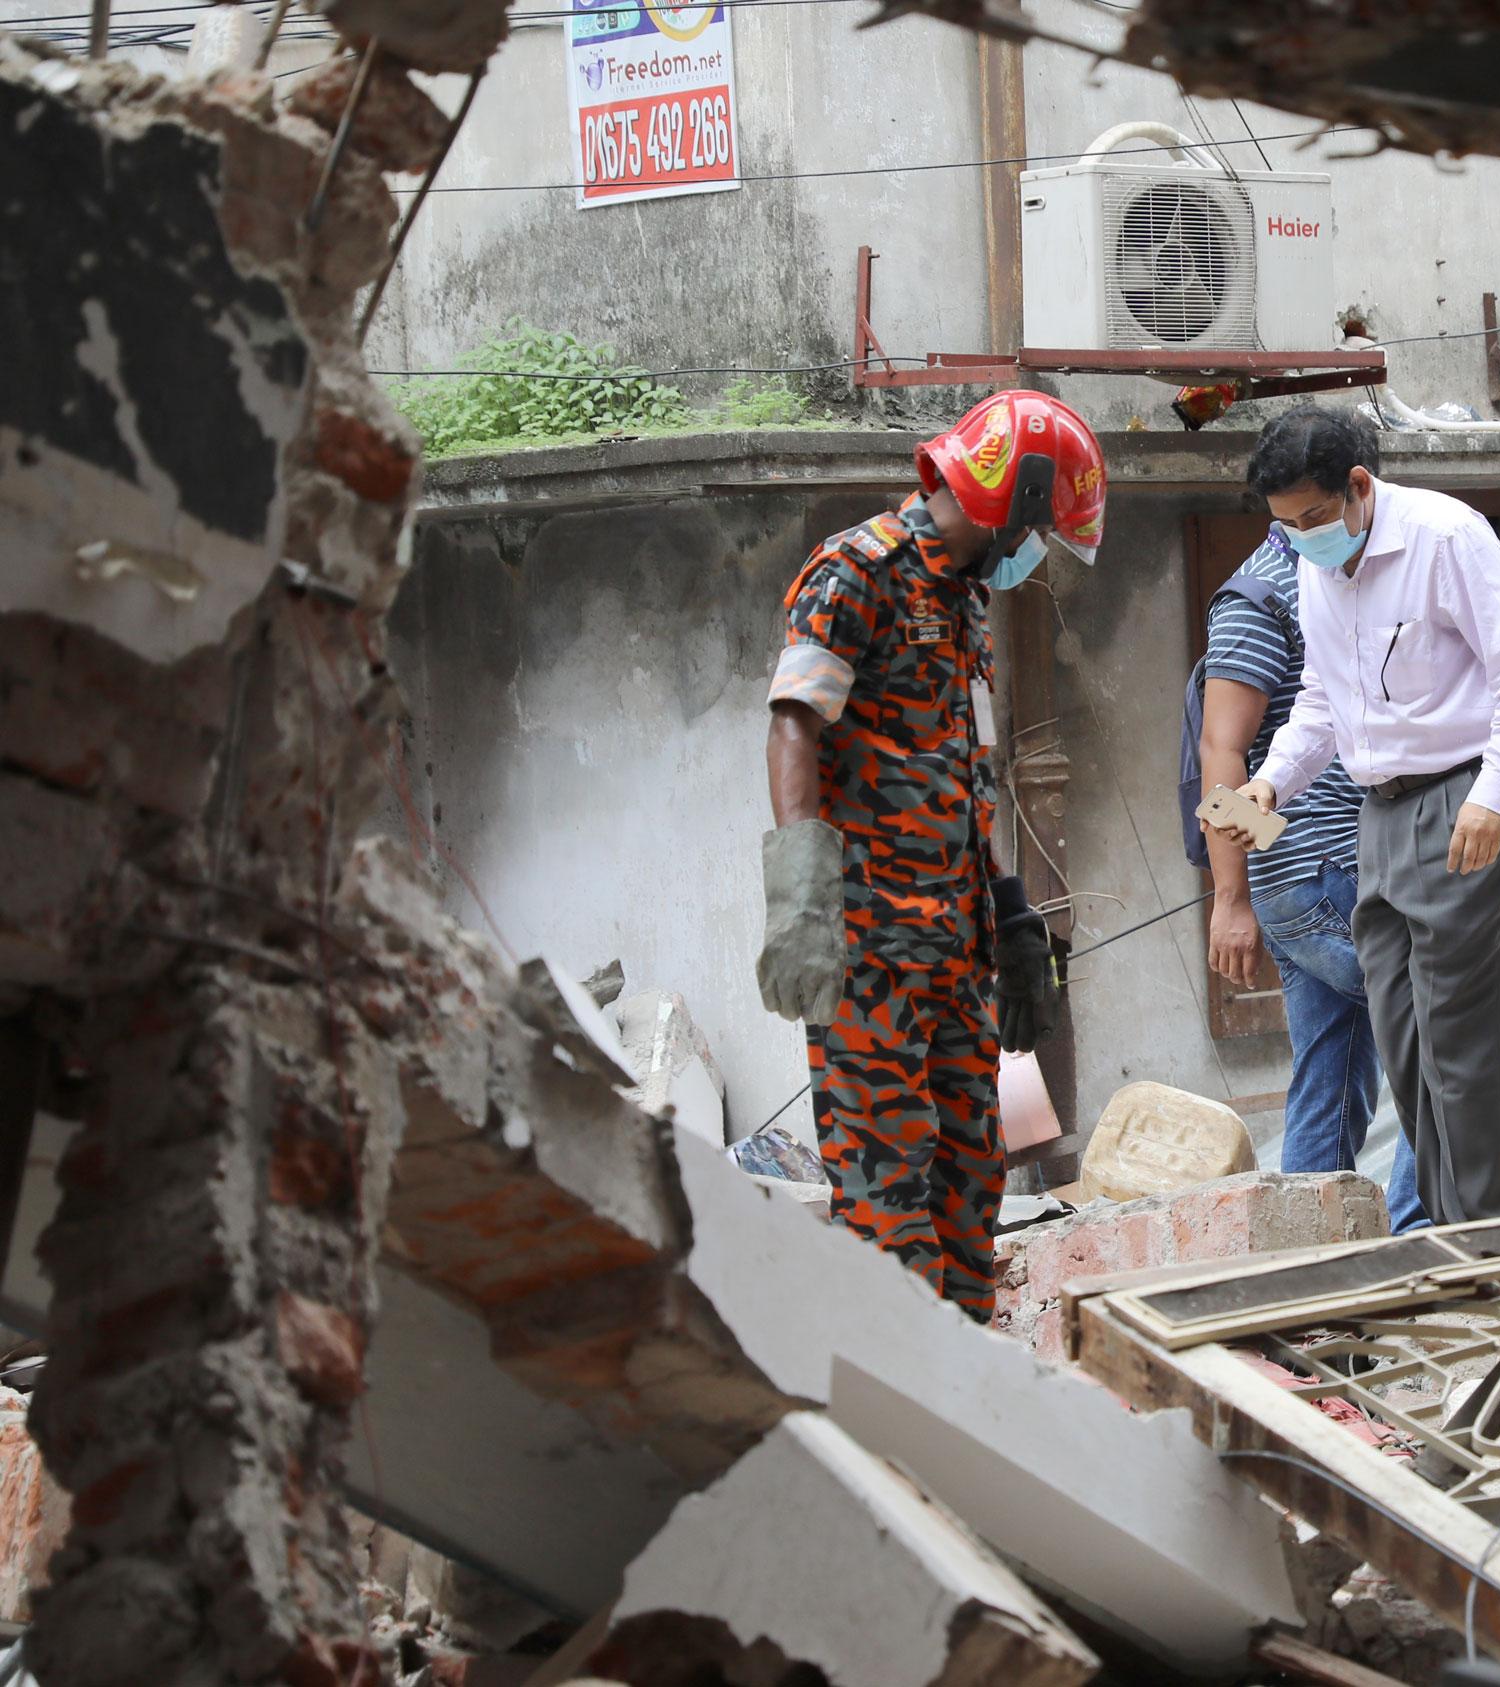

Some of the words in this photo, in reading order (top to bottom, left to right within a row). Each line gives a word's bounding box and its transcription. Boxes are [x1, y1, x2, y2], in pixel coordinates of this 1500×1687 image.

[606, 50, 723, 85] Freedom.net
[585, 109, 642, 183] 01675
[646, 101, 687, 173] 492
[689, 95, 730, 168] 266
[1267, 216, 1320, 238] Haier
